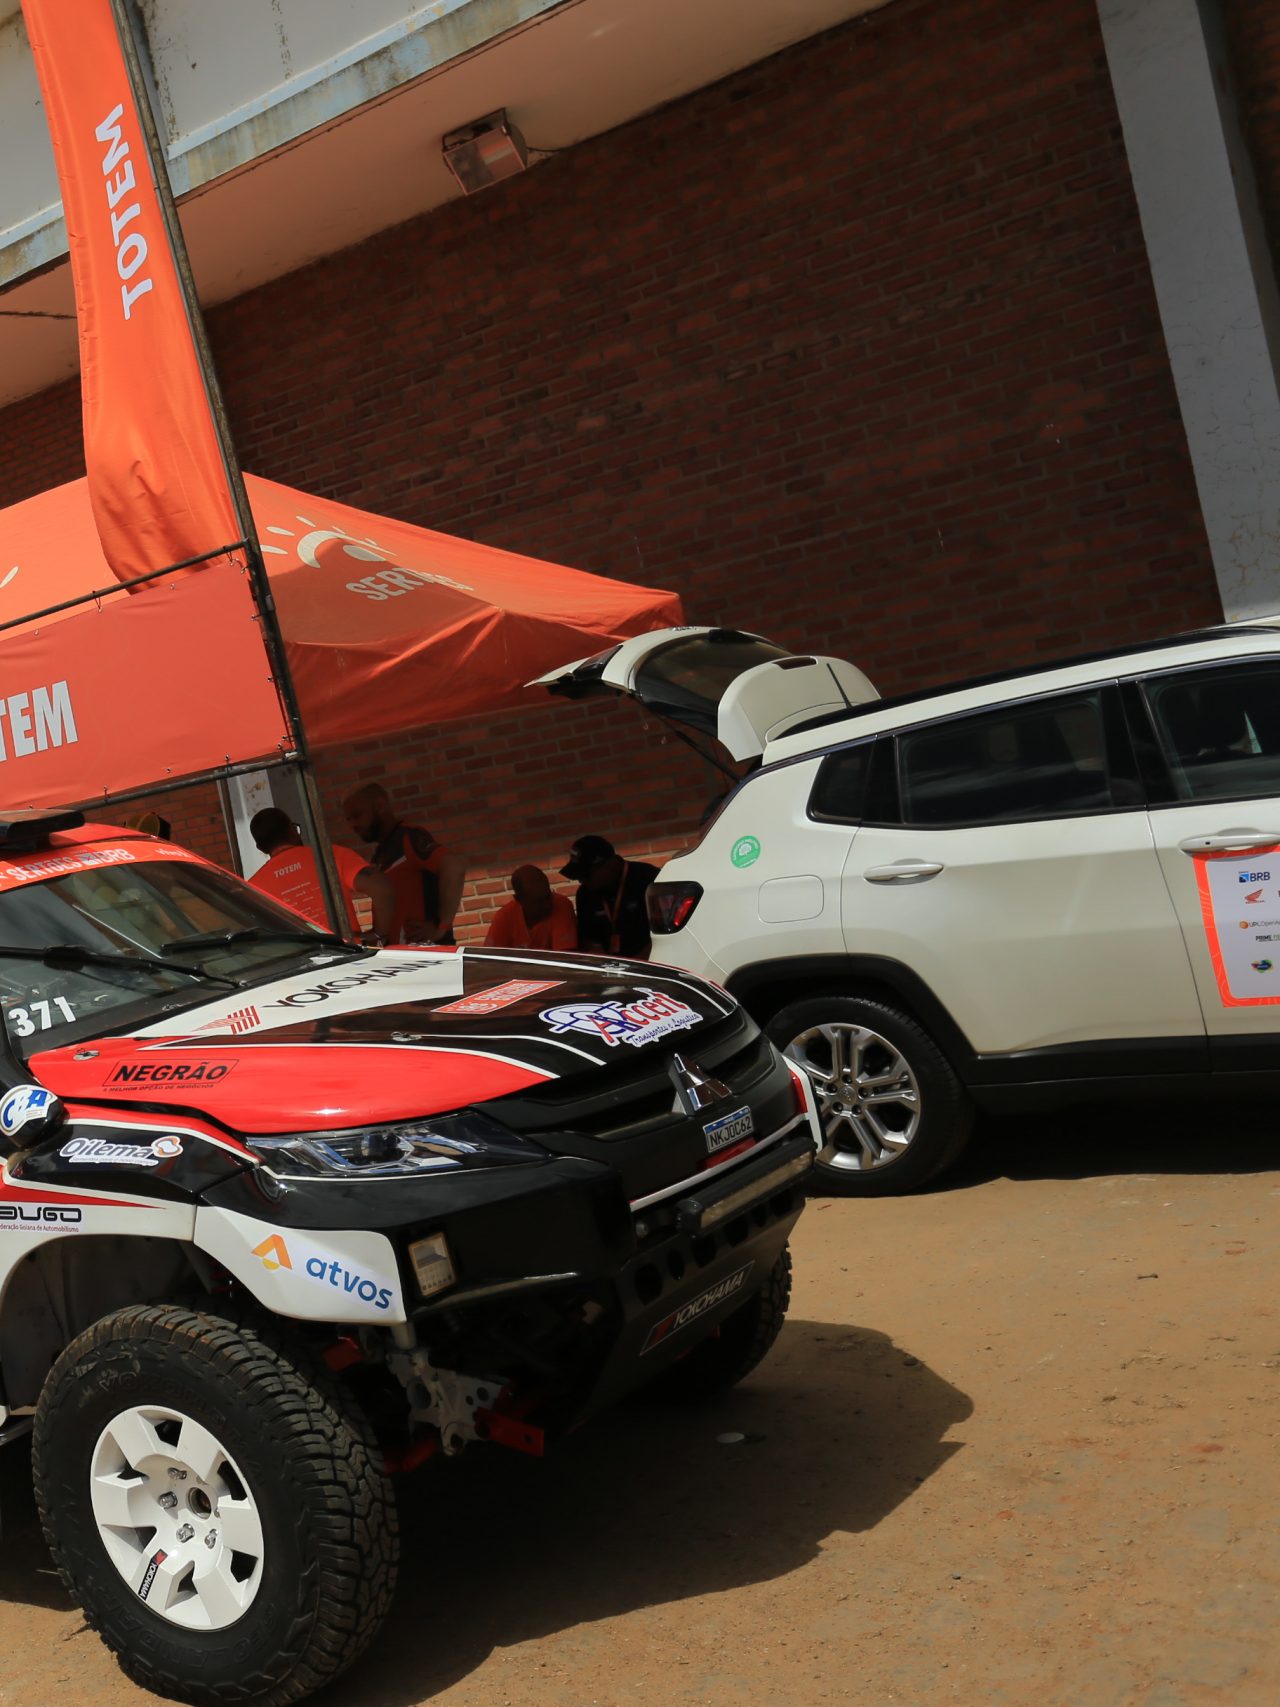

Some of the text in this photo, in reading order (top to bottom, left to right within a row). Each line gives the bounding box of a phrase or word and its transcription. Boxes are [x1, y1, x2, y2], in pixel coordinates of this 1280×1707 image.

[95, 103, 153, 320] TOTEM
[274, 862, 301, 878] TOTEM
[1250, 871, 1270, 881] BRB
[264, 958, 461, 1010] YOKOHAMA
[8, 996, 77, 1037] 371
[112, 1062, 228, 1083] NEGRÃO
[63, 1138, 153, 1159] Oilema
[306, 1257, 393, 1310] atvos
[673, 1270, 745, 1329] YOKOHAMA
[140, 1562, 158, 1598] YOKOHAMA
